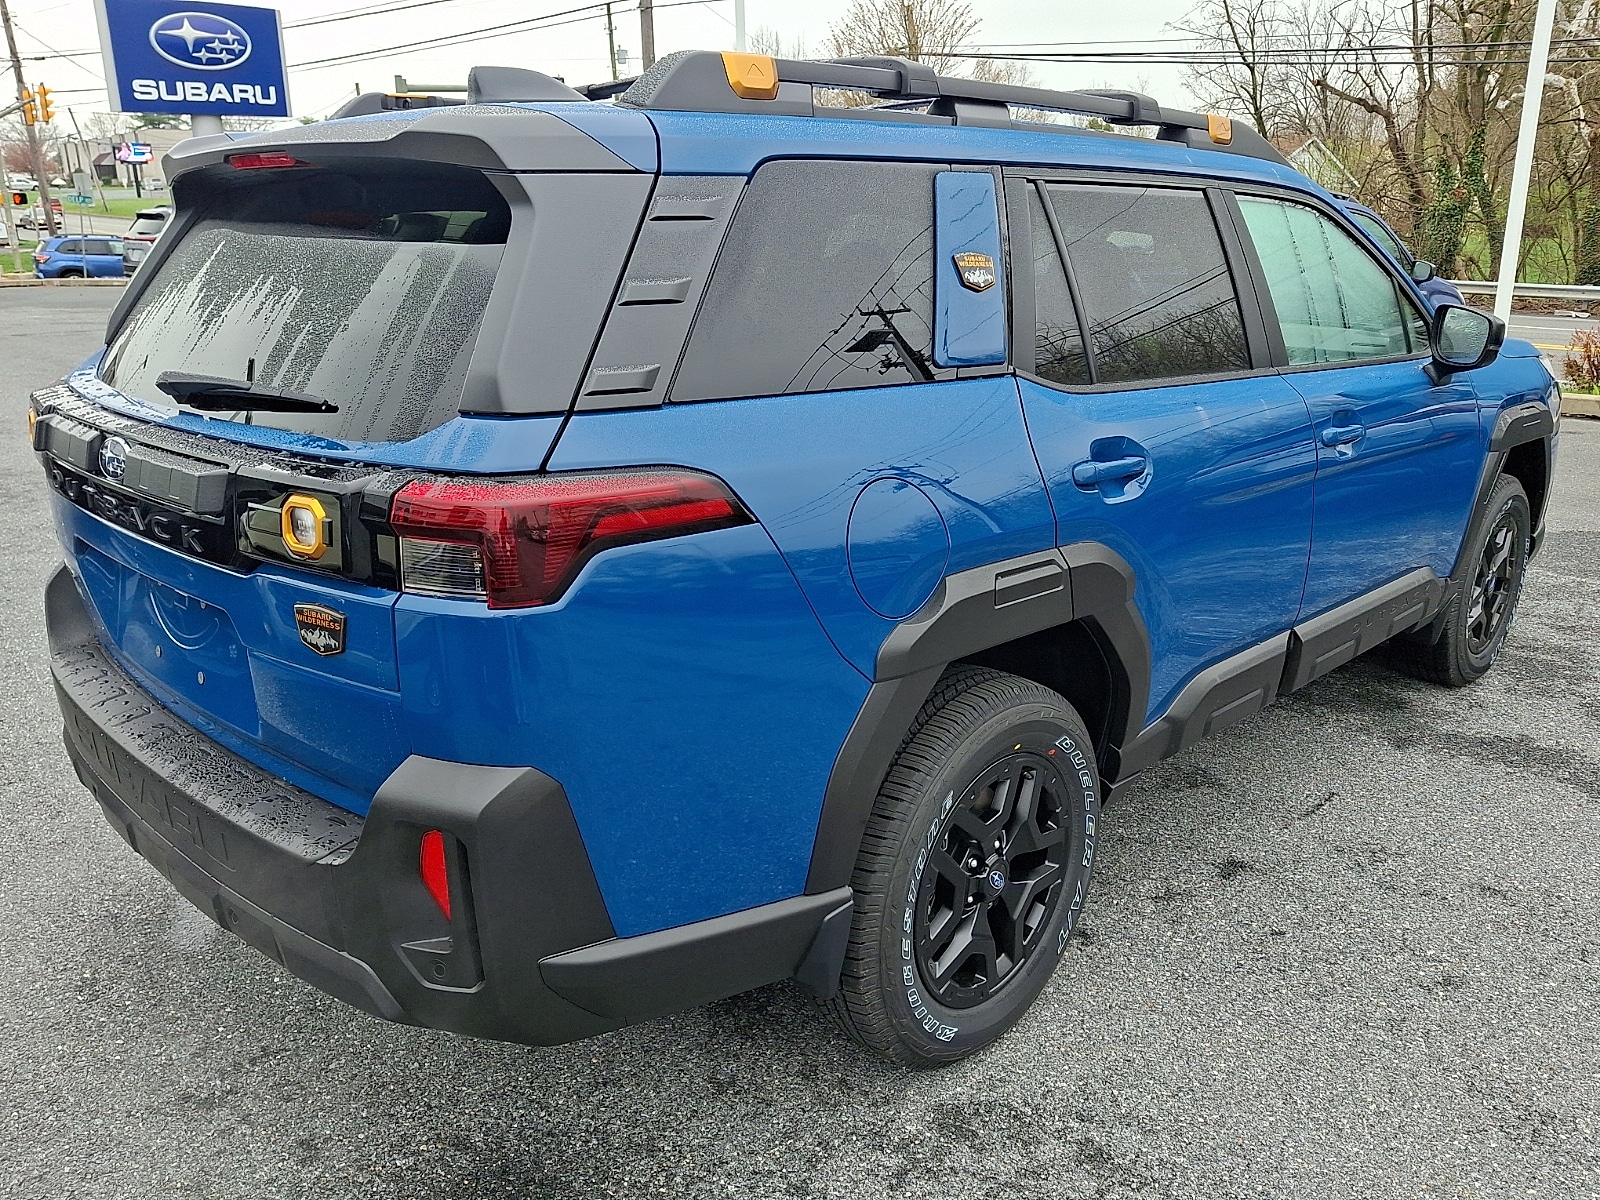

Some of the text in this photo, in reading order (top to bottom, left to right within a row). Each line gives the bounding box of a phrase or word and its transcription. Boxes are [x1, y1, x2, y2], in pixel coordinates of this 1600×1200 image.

[131, 79, 277, 105] SUBARU
[51, 468, 204, 552] OUTBACK
[296, 614, 341, 630] WILDERNESS
[303, 609, 332, 621] SUBARU
[73, 712, 237, 873] SUBARU
[1055, 735, 1096, 868] DUELER
[901, 790, 958, 1041] BRIDGESTONE
